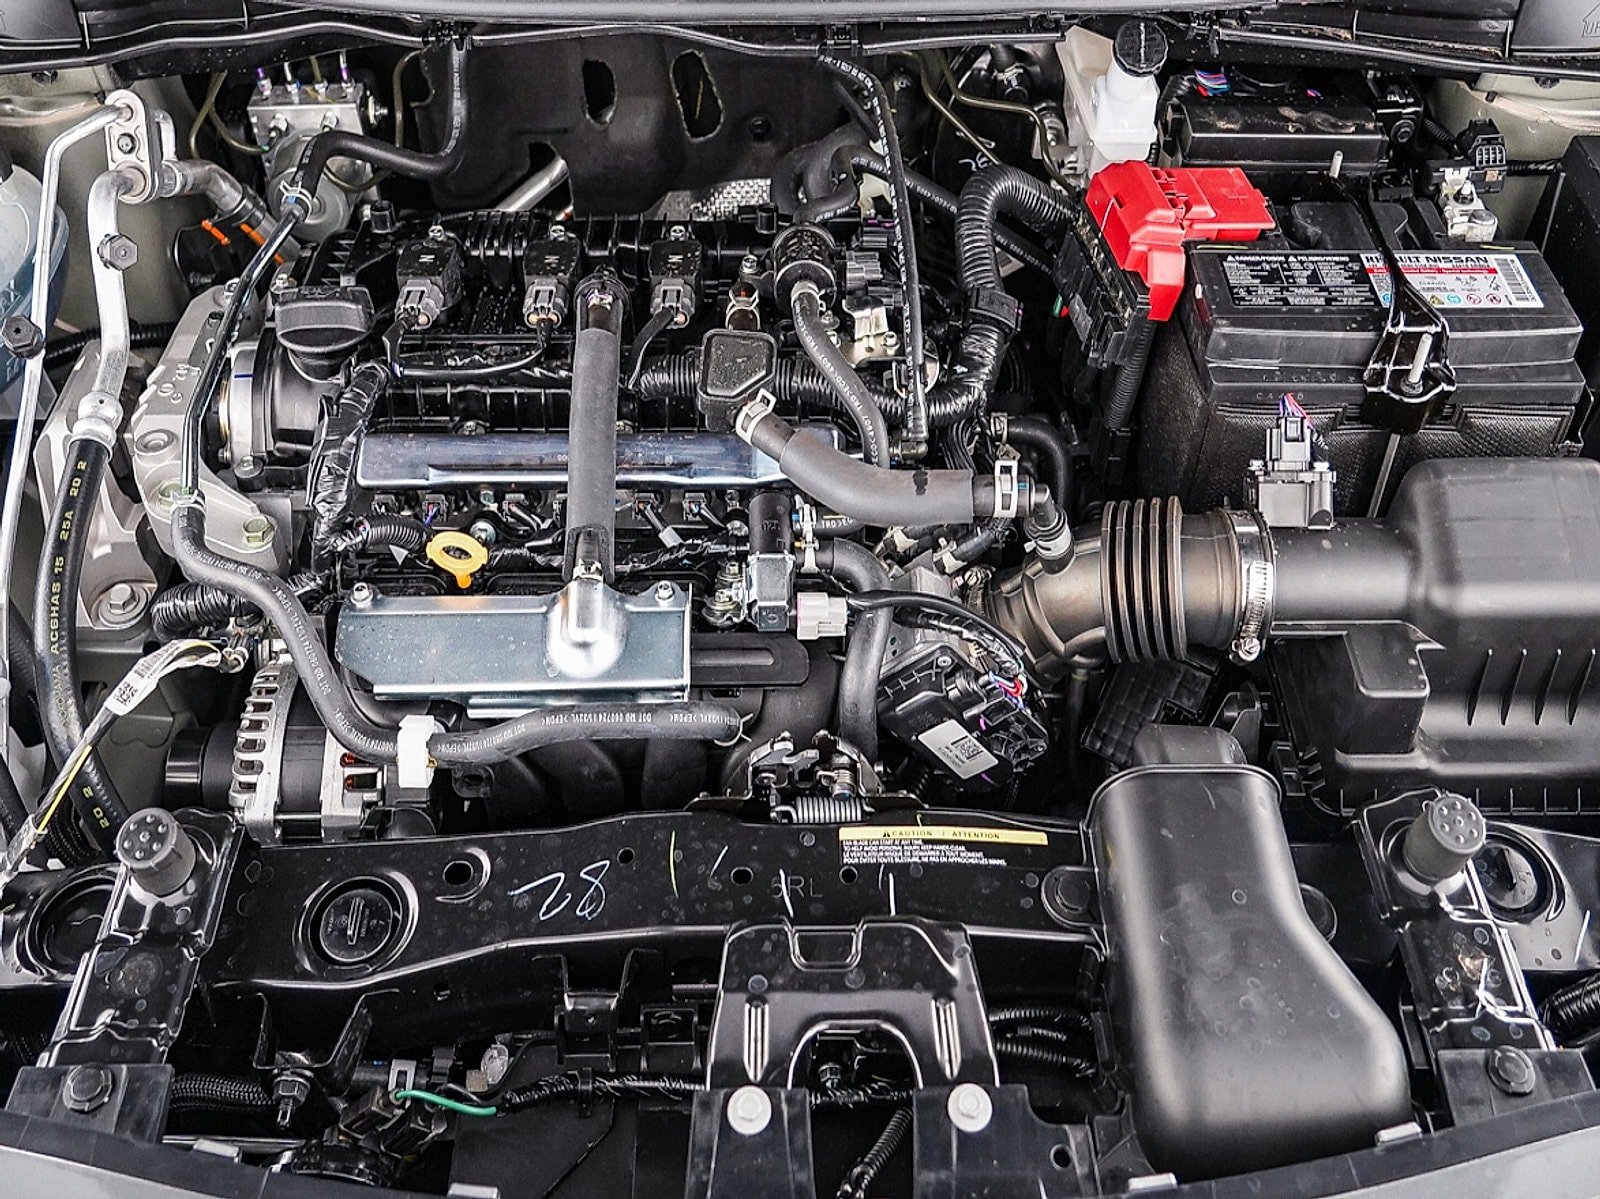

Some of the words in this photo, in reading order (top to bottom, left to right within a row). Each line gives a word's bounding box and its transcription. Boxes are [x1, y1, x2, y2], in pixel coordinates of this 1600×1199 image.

[1425, 256, 1489, 264] NISSAN
[54, 556, 65, 575] 15
[60, 510, 75, 541] 25A
[77, 460, 88, 470] 2
[952, 831, 1000, 839] ATTENTION
